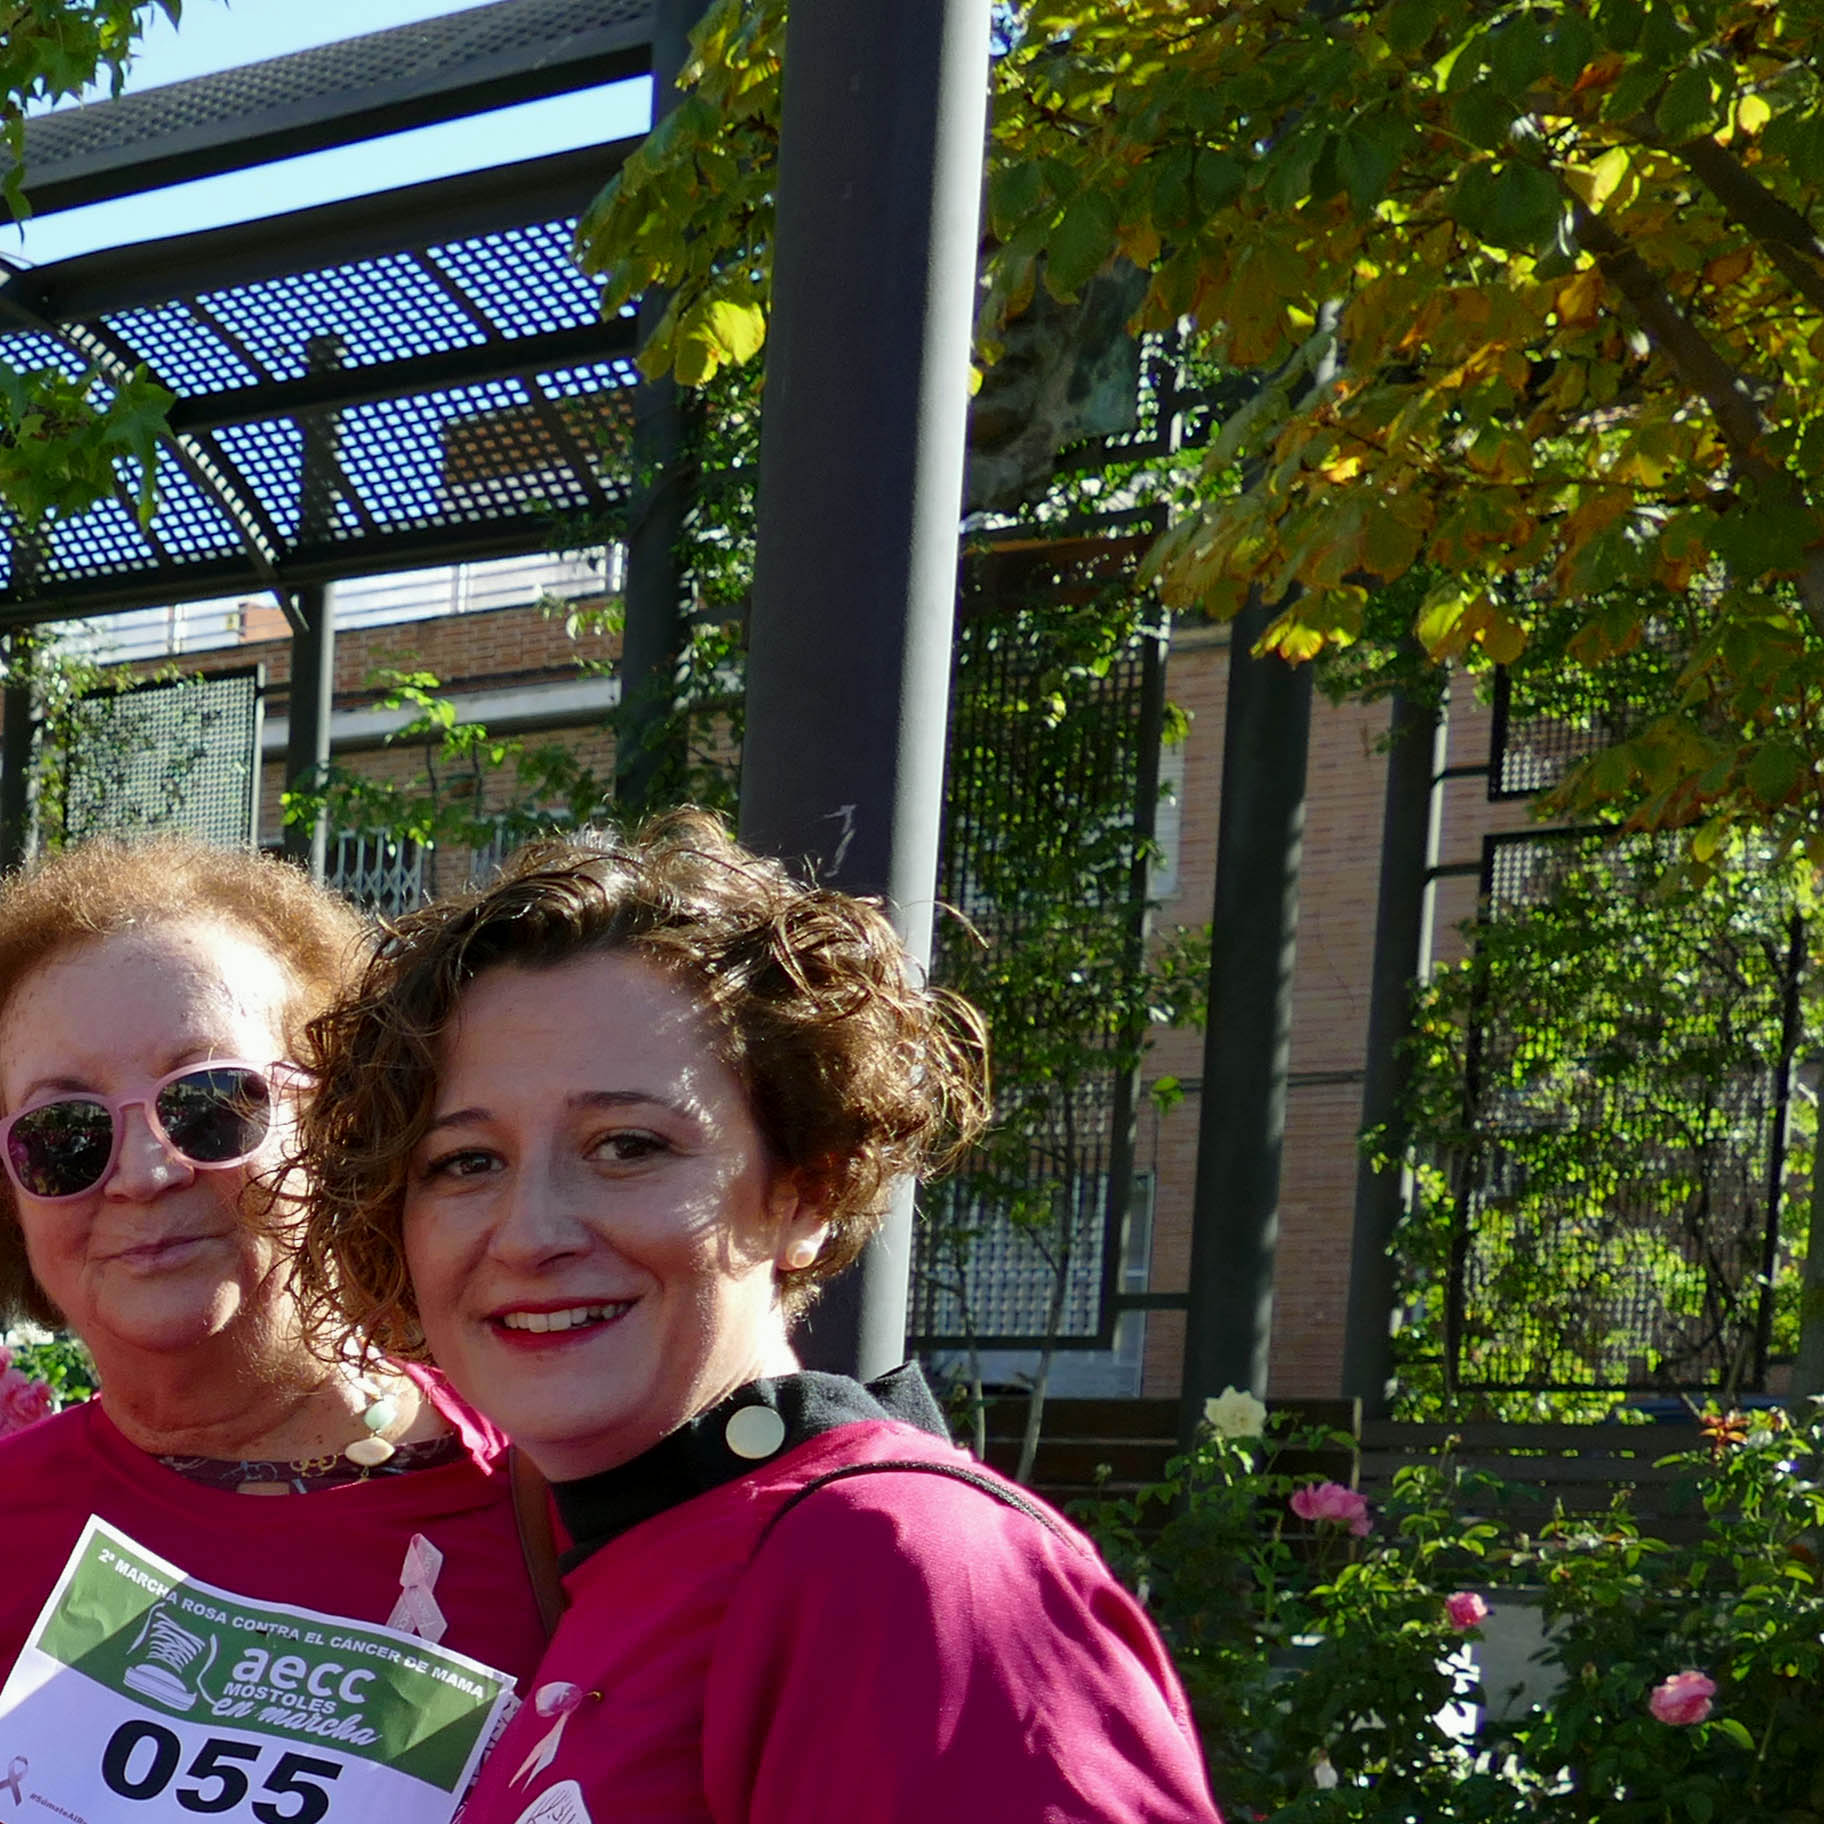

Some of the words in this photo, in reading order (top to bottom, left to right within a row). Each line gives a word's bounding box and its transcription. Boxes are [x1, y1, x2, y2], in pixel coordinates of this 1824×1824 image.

[114, 1558, 179, 1606] MARCHA
[180, 1597, 228, 1626] ROSA
[231, 1615, 300, 1641] CONTRA
[304, 1631, 327, 1646] EL
[329, 1633, 402, 1665] CÁNCER
[402, 1655, 428, 1676] DE
[431, 1664, 485, 1699] MAMA
[231, 1646, 376, 1705] aecc
[210, 1695, 254, 1721] en
[255, 1702, 384, 1748] marcha
